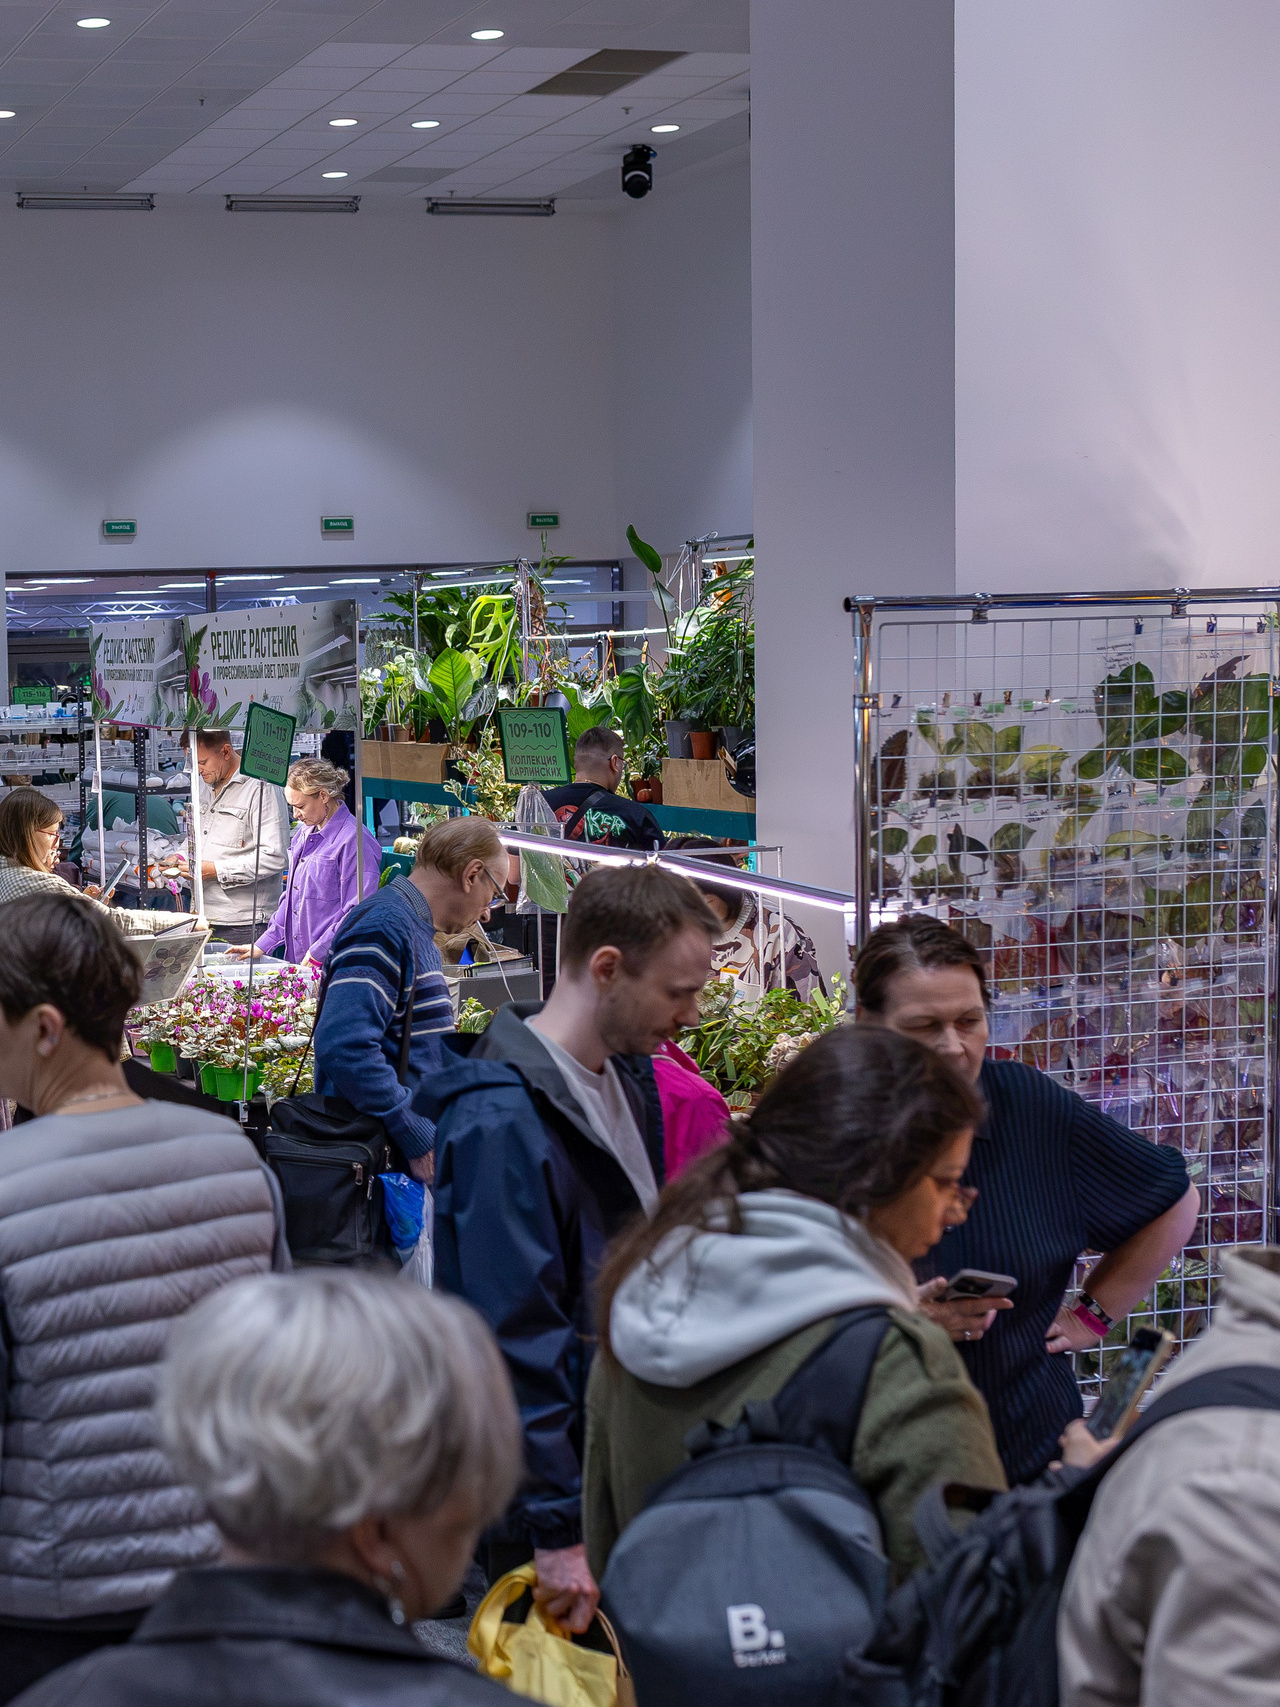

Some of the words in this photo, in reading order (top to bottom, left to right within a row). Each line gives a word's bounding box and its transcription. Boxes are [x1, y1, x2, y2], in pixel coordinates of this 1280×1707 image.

[210, 629, 247, 663] РЕДКИЕ
[249, 625, 299, 659] РАСТЕНИЯ
[22, 690, 47, 698] 115-116
[508, 722, 552, 739] 109-110
[510, 755, 558, 767] КОЛЛЕКЦИЯ
[509, 766, 562, 778] КАРЛИНСКИХ
